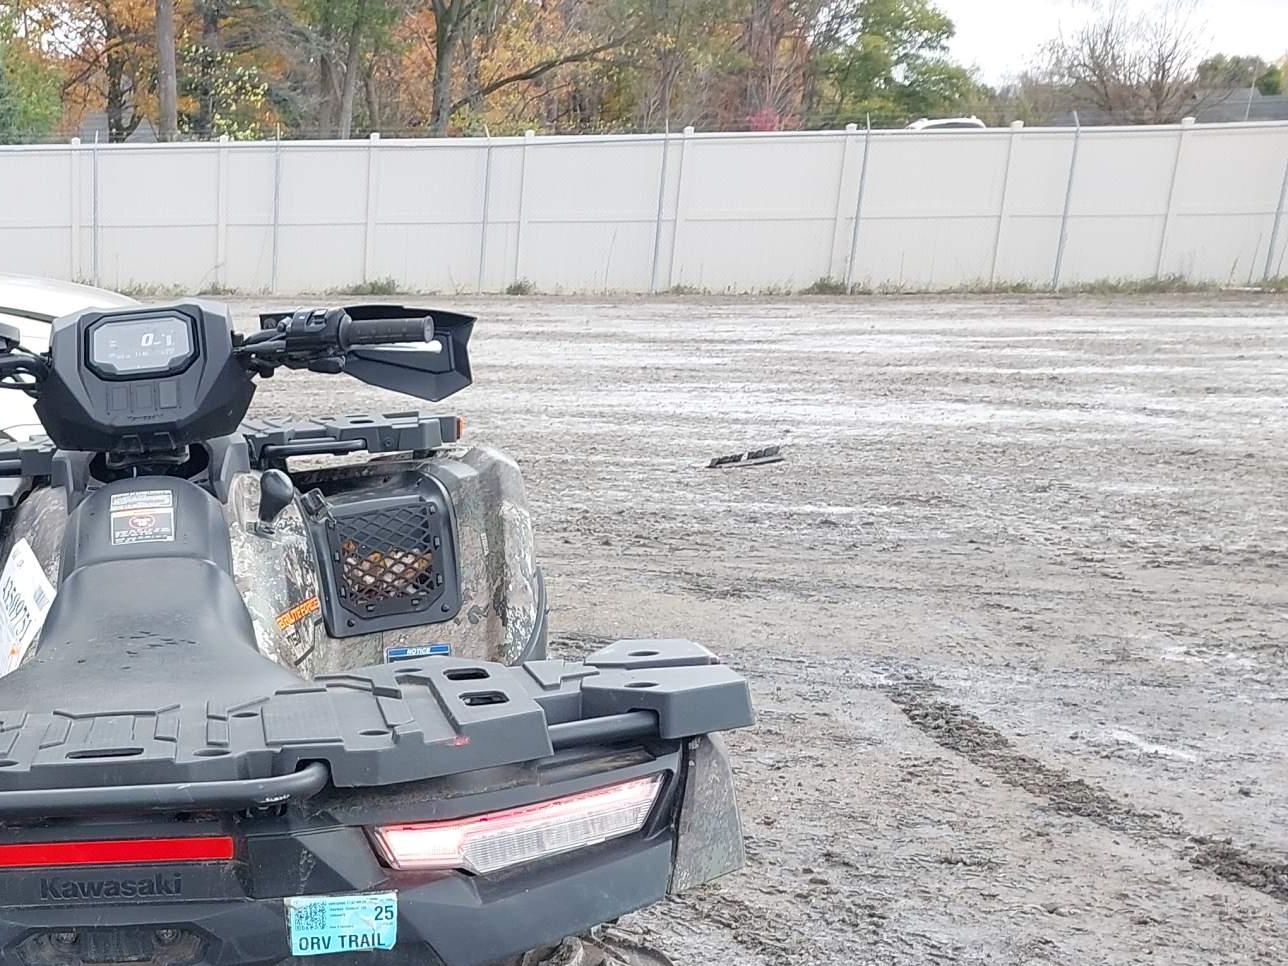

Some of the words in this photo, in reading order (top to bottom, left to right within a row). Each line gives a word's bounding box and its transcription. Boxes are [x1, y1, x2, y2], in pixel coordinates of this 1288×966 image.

[407, 647, 431, 656] NOTICE
[41, 873, 183, 901] Kawasaki
[374, 905, 394, 921] 25
[299, 936, 332, 951] ORV
[338, 932, 386, 949] TRAIL
